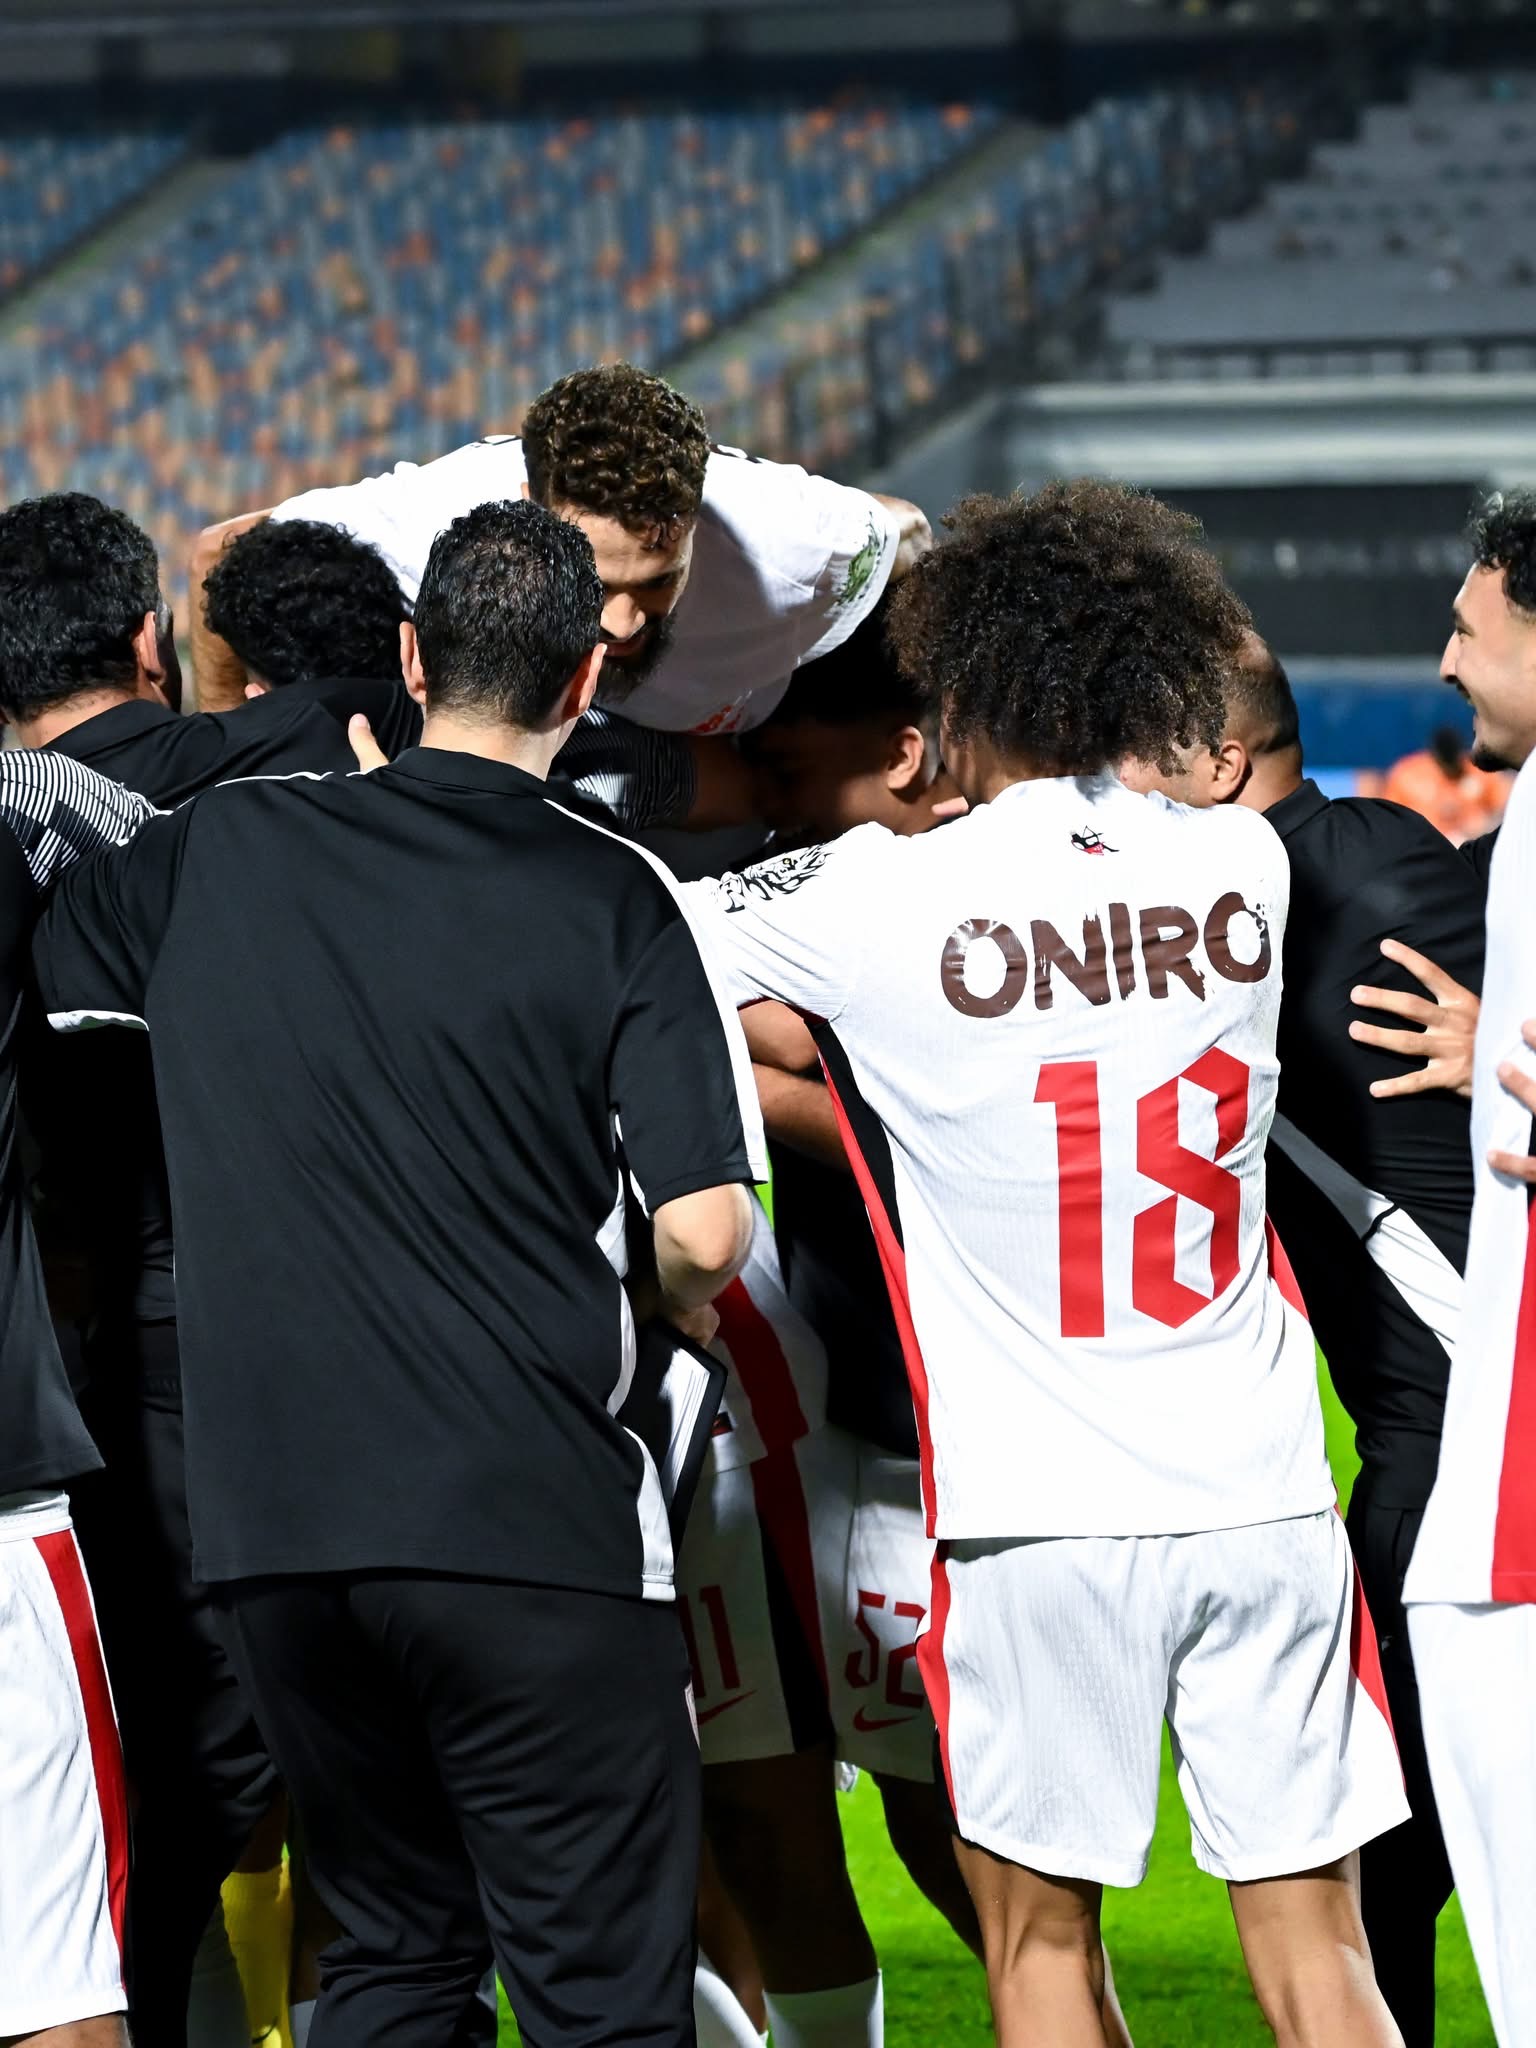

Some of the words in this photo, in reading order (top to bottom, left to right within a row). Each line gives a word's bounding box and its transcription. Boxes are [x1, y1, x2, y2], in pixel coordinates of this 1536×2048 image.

[941, 892, 1272, 1018] ONIRO
[1033, 1046, 1250, 1337] 18
[845, 1588, 927, 1709] 52
